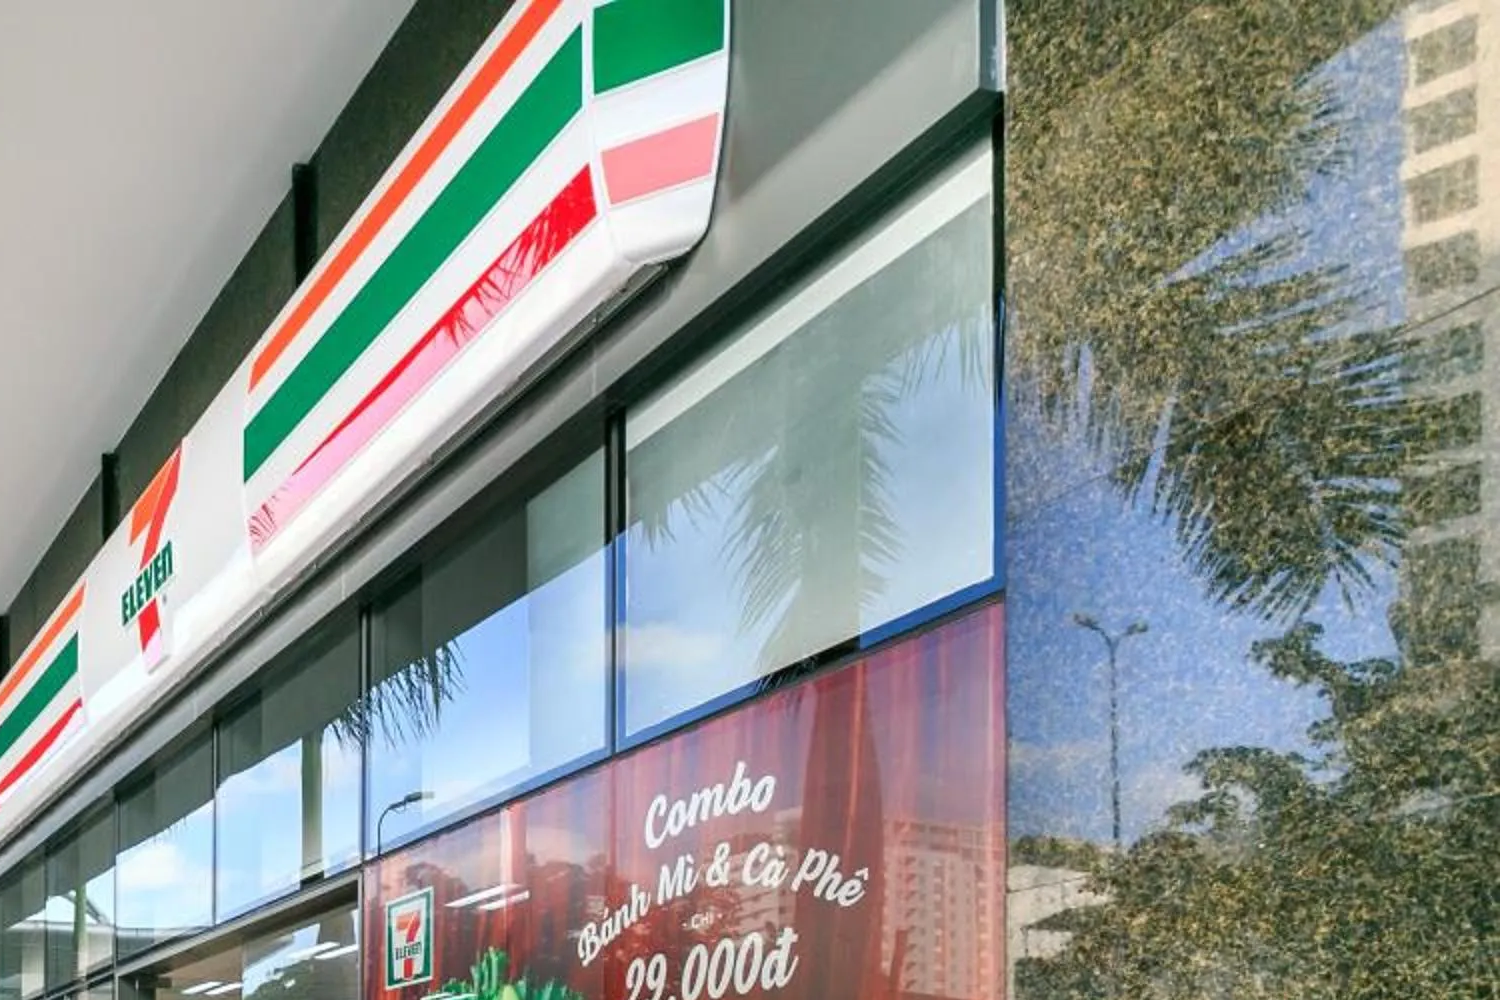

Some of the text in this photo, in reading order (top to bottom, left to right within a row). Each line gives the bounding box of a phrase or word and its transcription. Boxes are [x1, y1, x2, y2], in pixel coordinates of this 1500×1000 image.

[645, 761, 776, 849] Combo
[577, 842, 869, 967] Bánh Mì & Cà Phê
